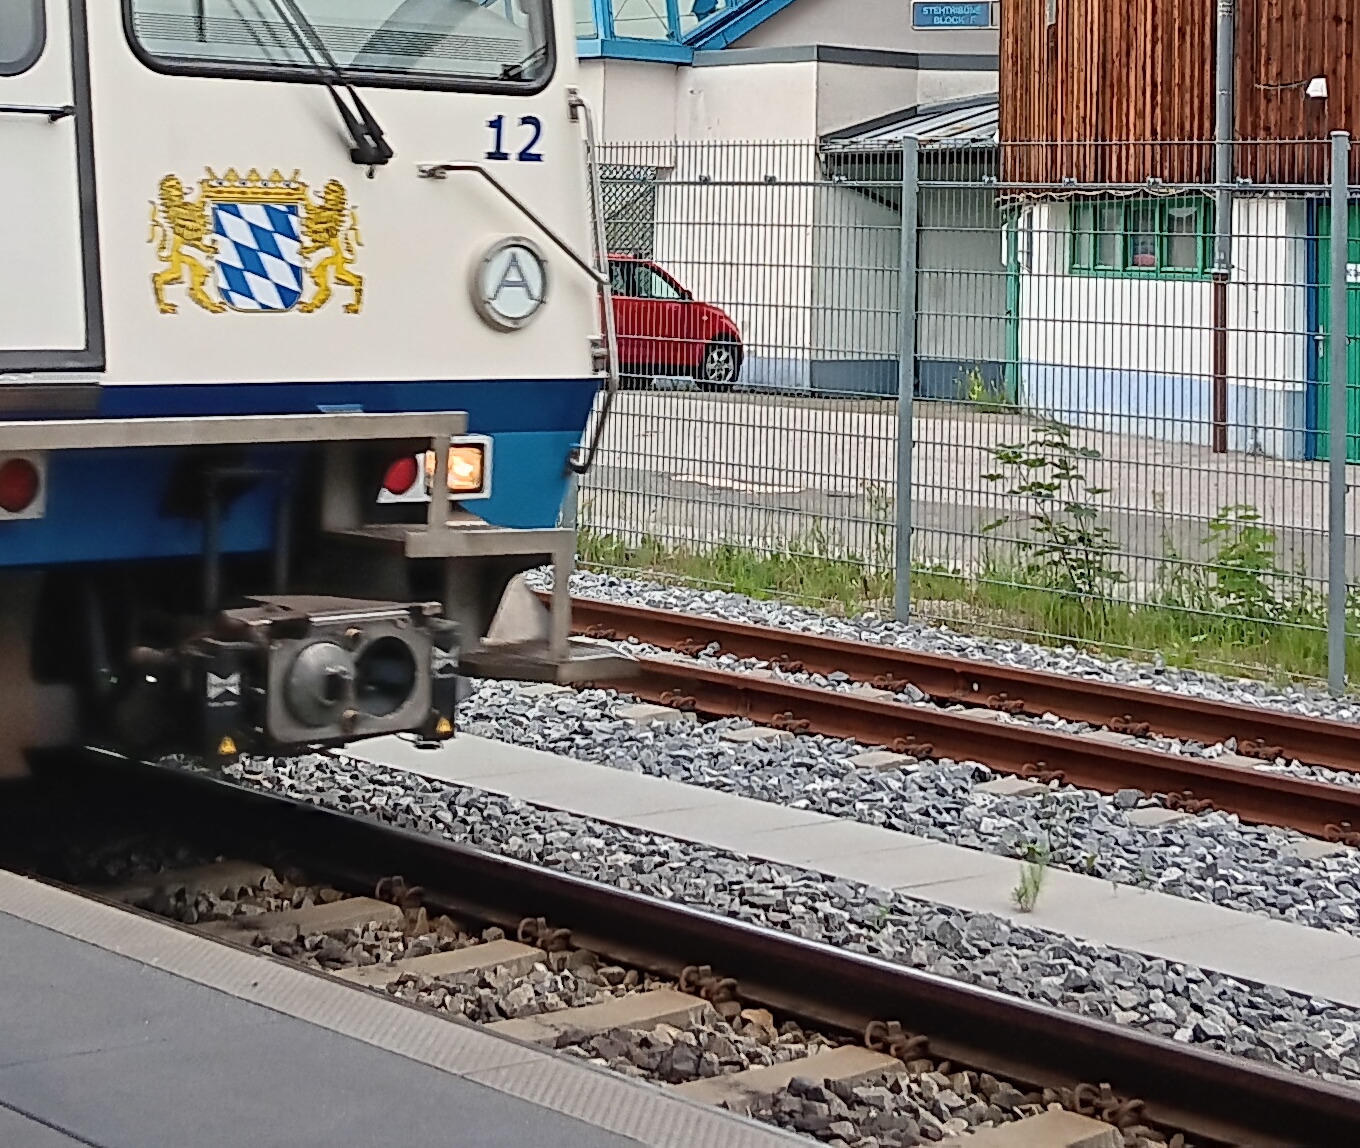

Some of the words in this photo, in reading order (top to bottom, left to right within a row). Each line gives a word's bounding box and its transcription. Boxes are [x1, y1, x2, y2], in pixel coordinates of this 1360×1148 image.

[933, 15, 965, 25] BLOCK
[484, 114, 544, 162] 12
[487, 251, 542, 302] A
